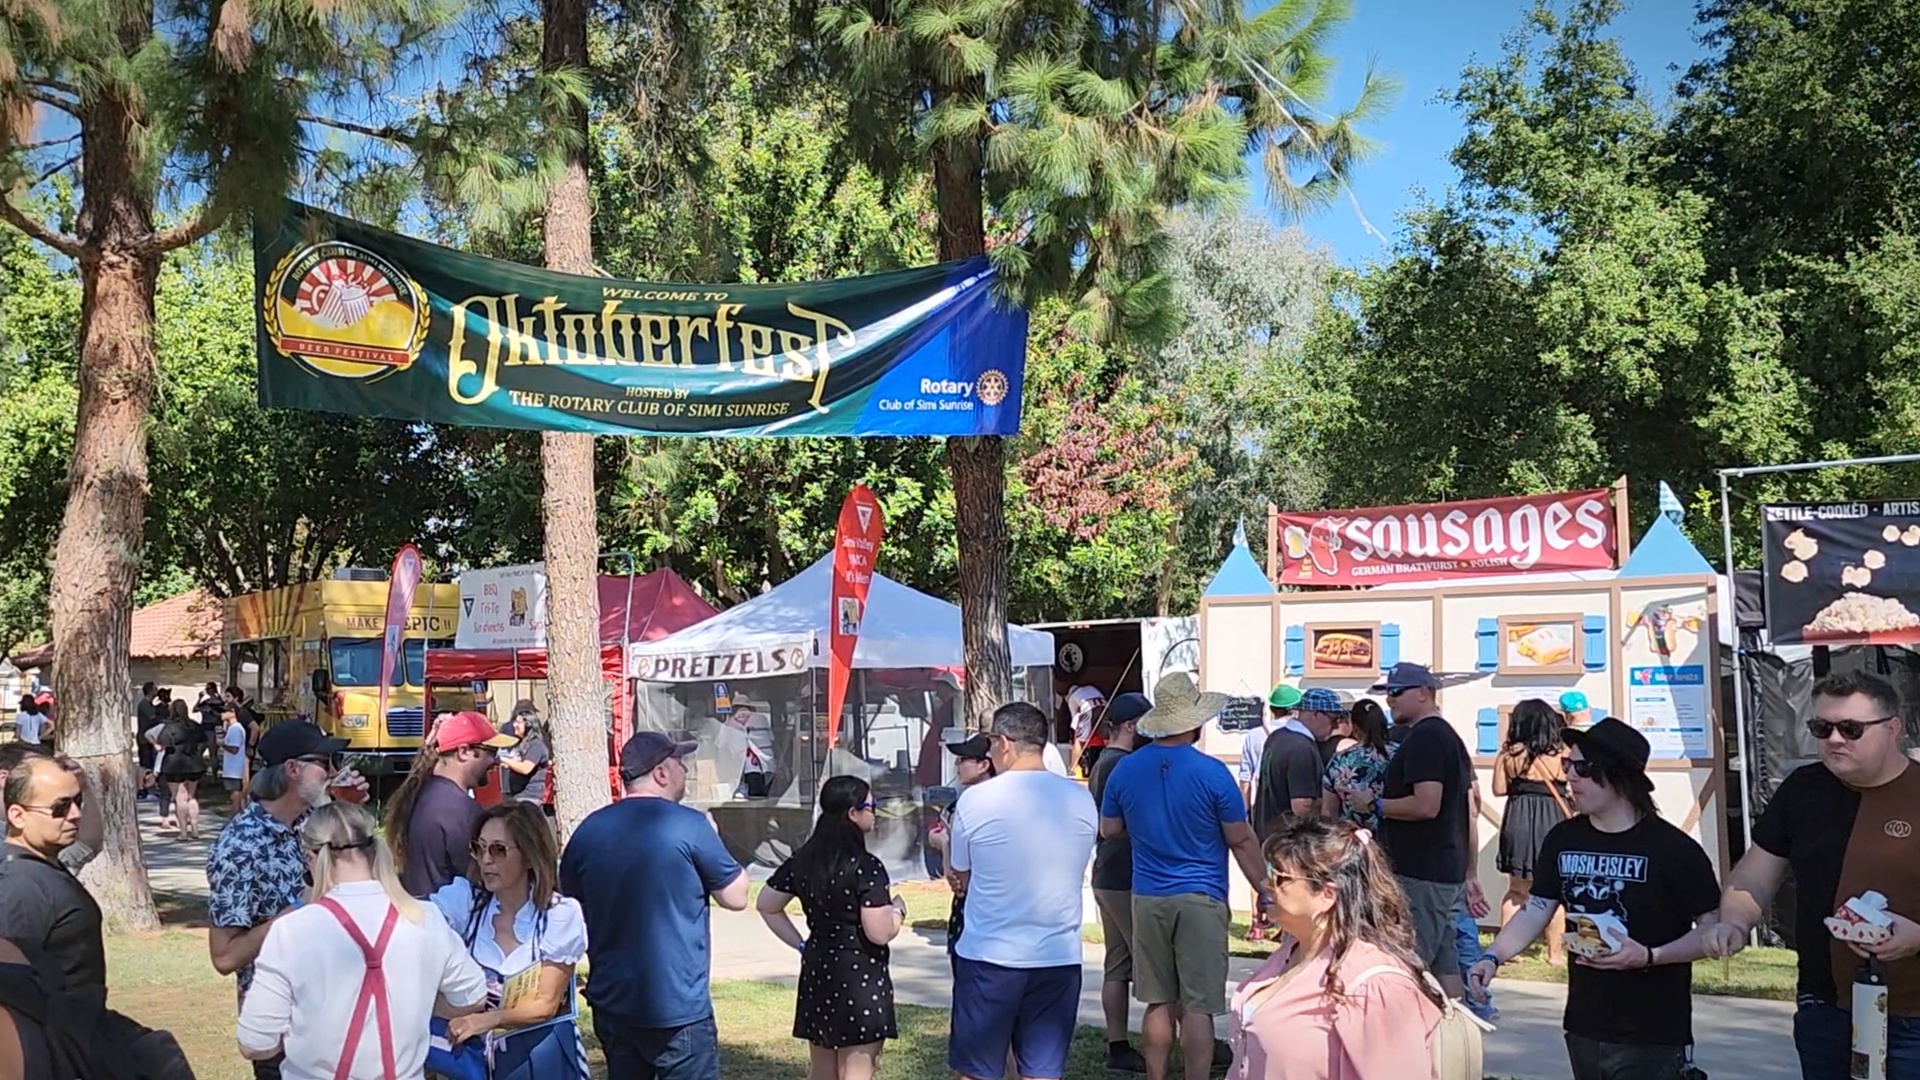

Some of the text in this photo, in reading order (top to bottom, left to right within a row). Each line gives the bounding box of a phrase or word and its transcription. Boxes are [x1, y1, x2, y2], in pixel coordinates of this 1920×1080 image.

[291, 251, 320, 281] ROTARY
[602, 287, 729, 301] WELCOME TO
[299, 343, 394, 361] BEER FESTIVAL
[625, 386, 690, 400] HOSTED BY
[920, 378, 974, 397] Rotary
[509, 390, 790, 417] THE ROTARY CLUB OF SIMI SUNRISE
[879, 399, 974, 411] Club of Simi Sunrise
[1766, 502, 1869, 522] KETTLE-COOKED
[1351, 557, 1509, 577] GERMAN BRATWURST POLISH
[346, 617, 379, 629] MAKE
[404, 615, 440, 632] EPIC
[650, 648, 787, 679] PRETZELS
[1598, 856, 1644, 878] EISLEY
